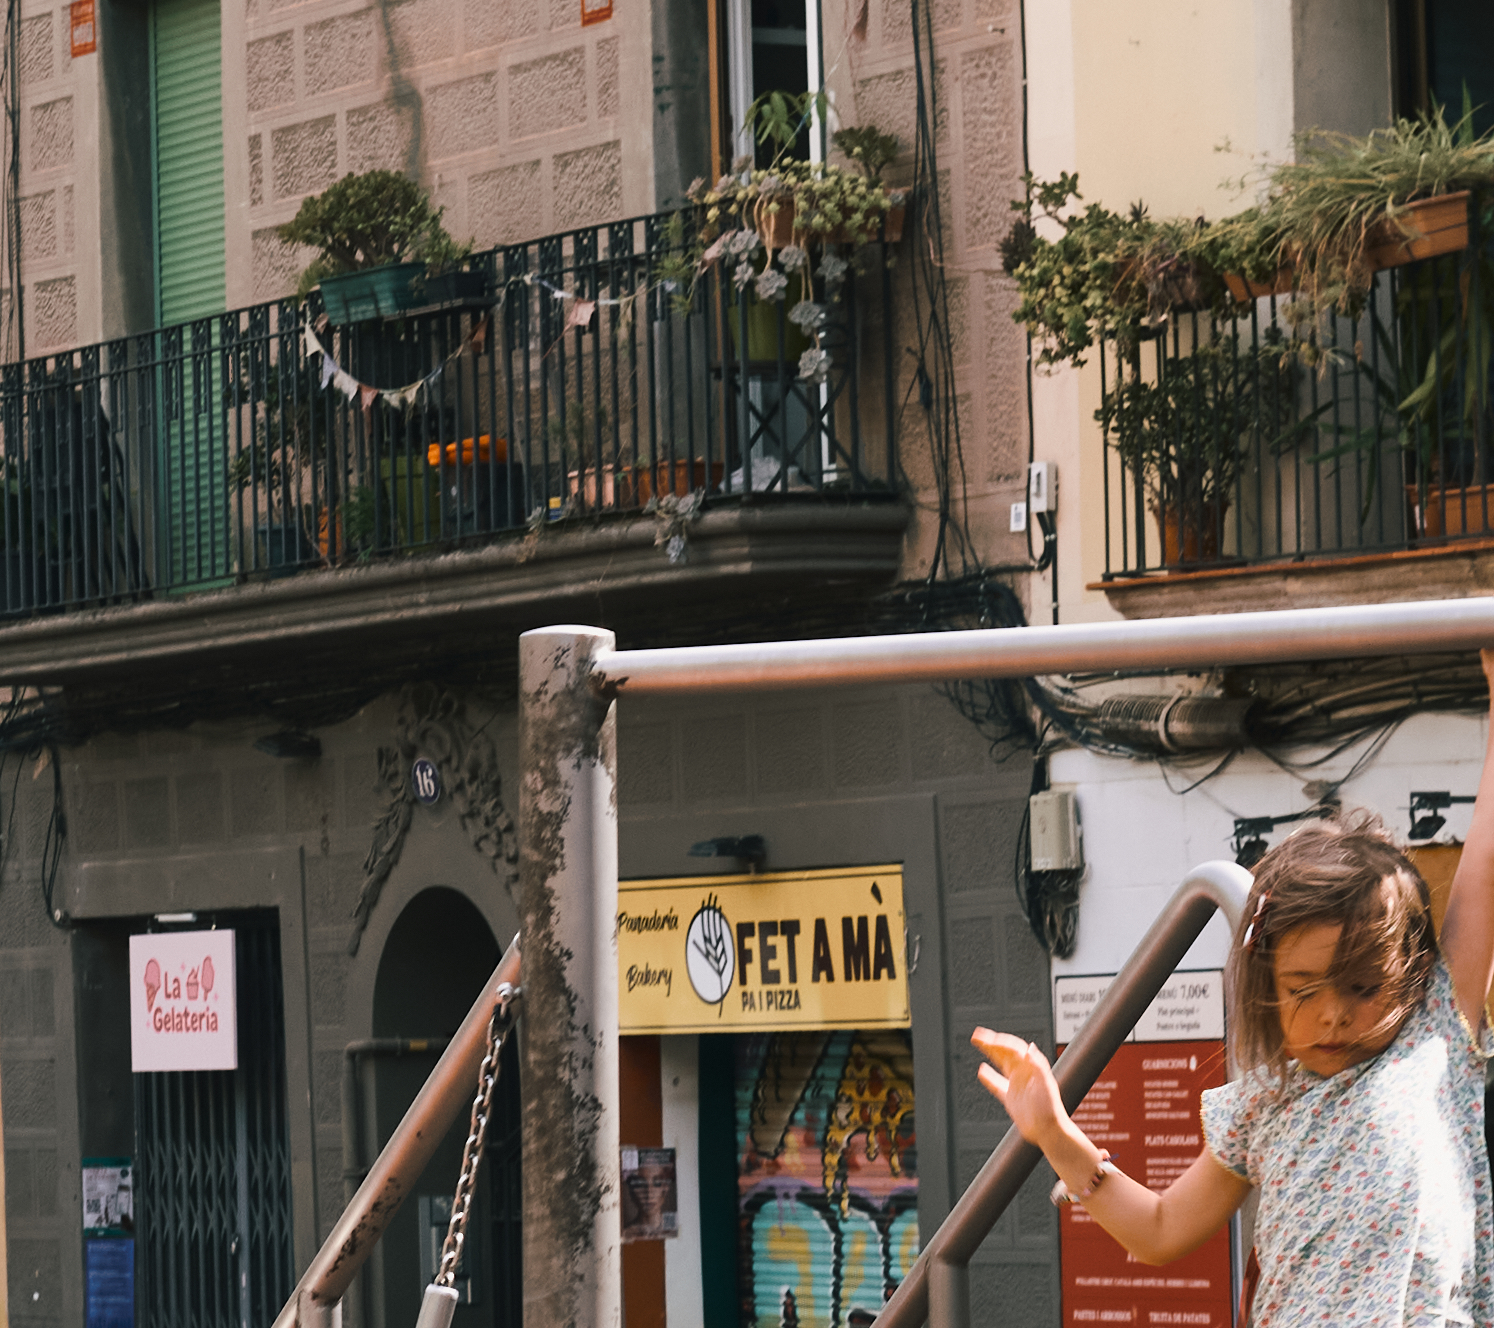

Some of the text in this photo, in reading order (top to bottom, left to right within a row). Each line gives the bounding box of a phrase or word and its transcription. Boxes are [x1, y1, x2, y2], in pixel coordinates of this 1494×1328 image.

[415, 763, 436, 798] 16
[736, 880, 897, 987] FET A MÀ
[163, 970, 182, 1000] La
[741, 991, 756, 1013] PA
[766, 988, 802, 1012] PIZZA
[152, 1005, 219, 1033] Gelateria
